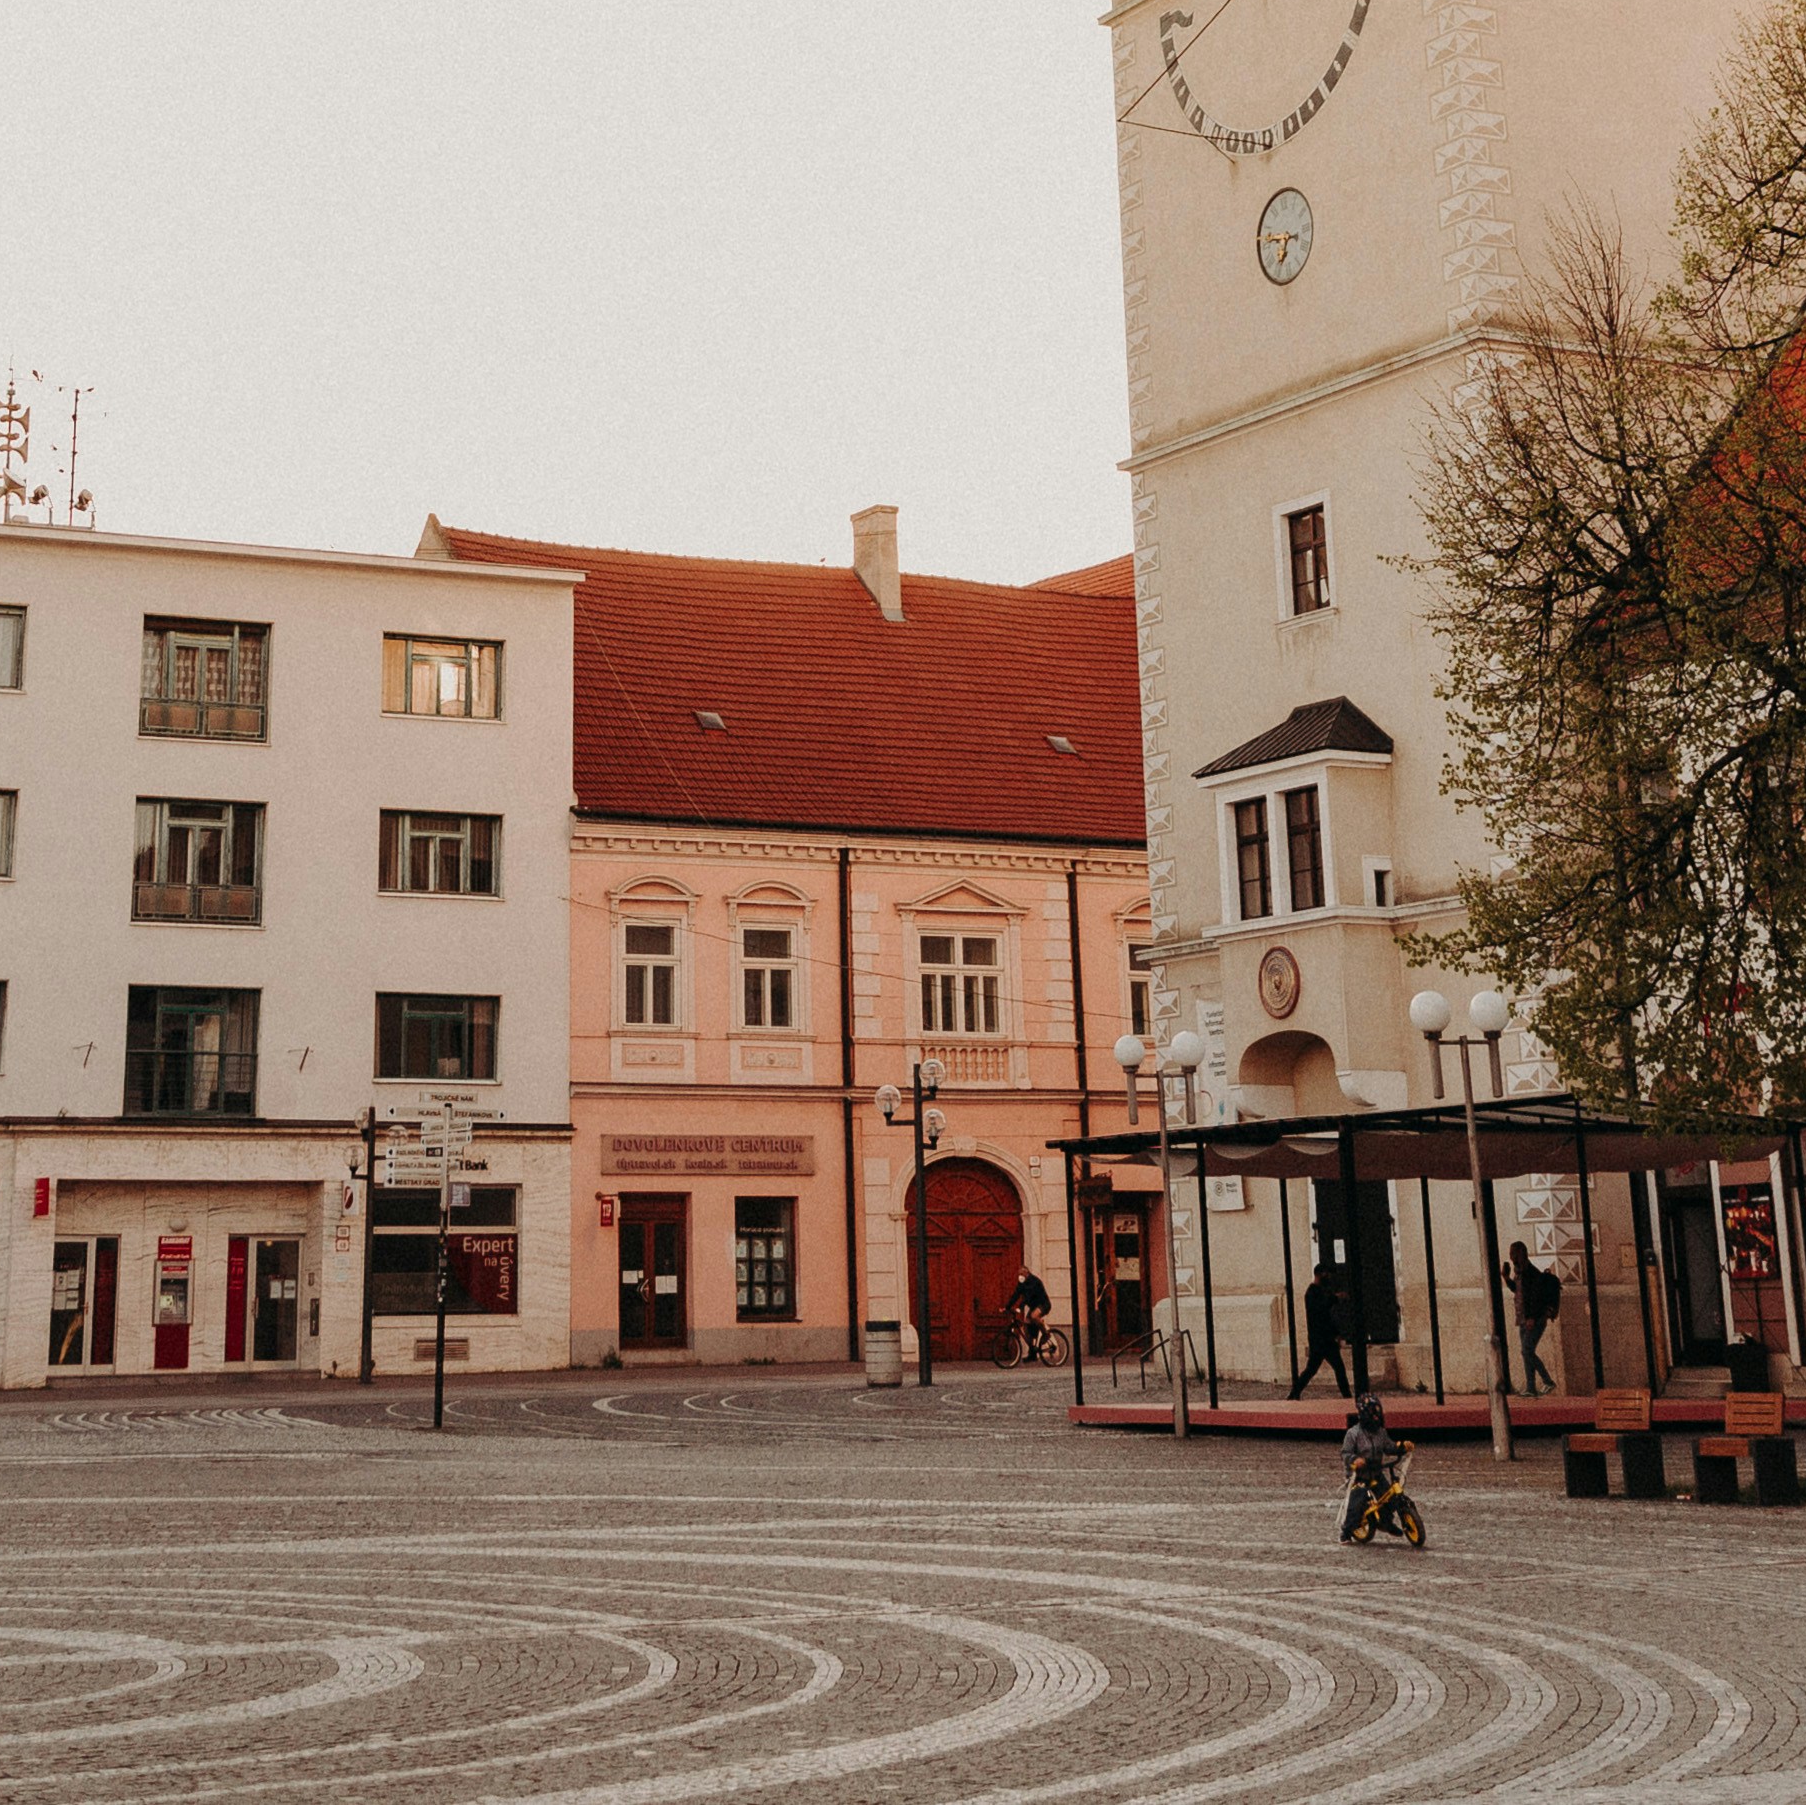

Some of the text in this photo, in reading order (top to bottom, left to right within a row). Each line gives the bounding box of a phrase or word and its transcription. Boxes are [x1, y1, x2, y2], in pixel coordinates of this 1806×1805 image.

[612, 1136, 804, 1153] DOVOLENKOVÉ CENTRUM
[465, 1158, 488, 1171] Bank
[463, 1237, 515, 1255] Expert
[484, 1257, 498, 1267] na
[497, 1256, 514, 1301] úvery
